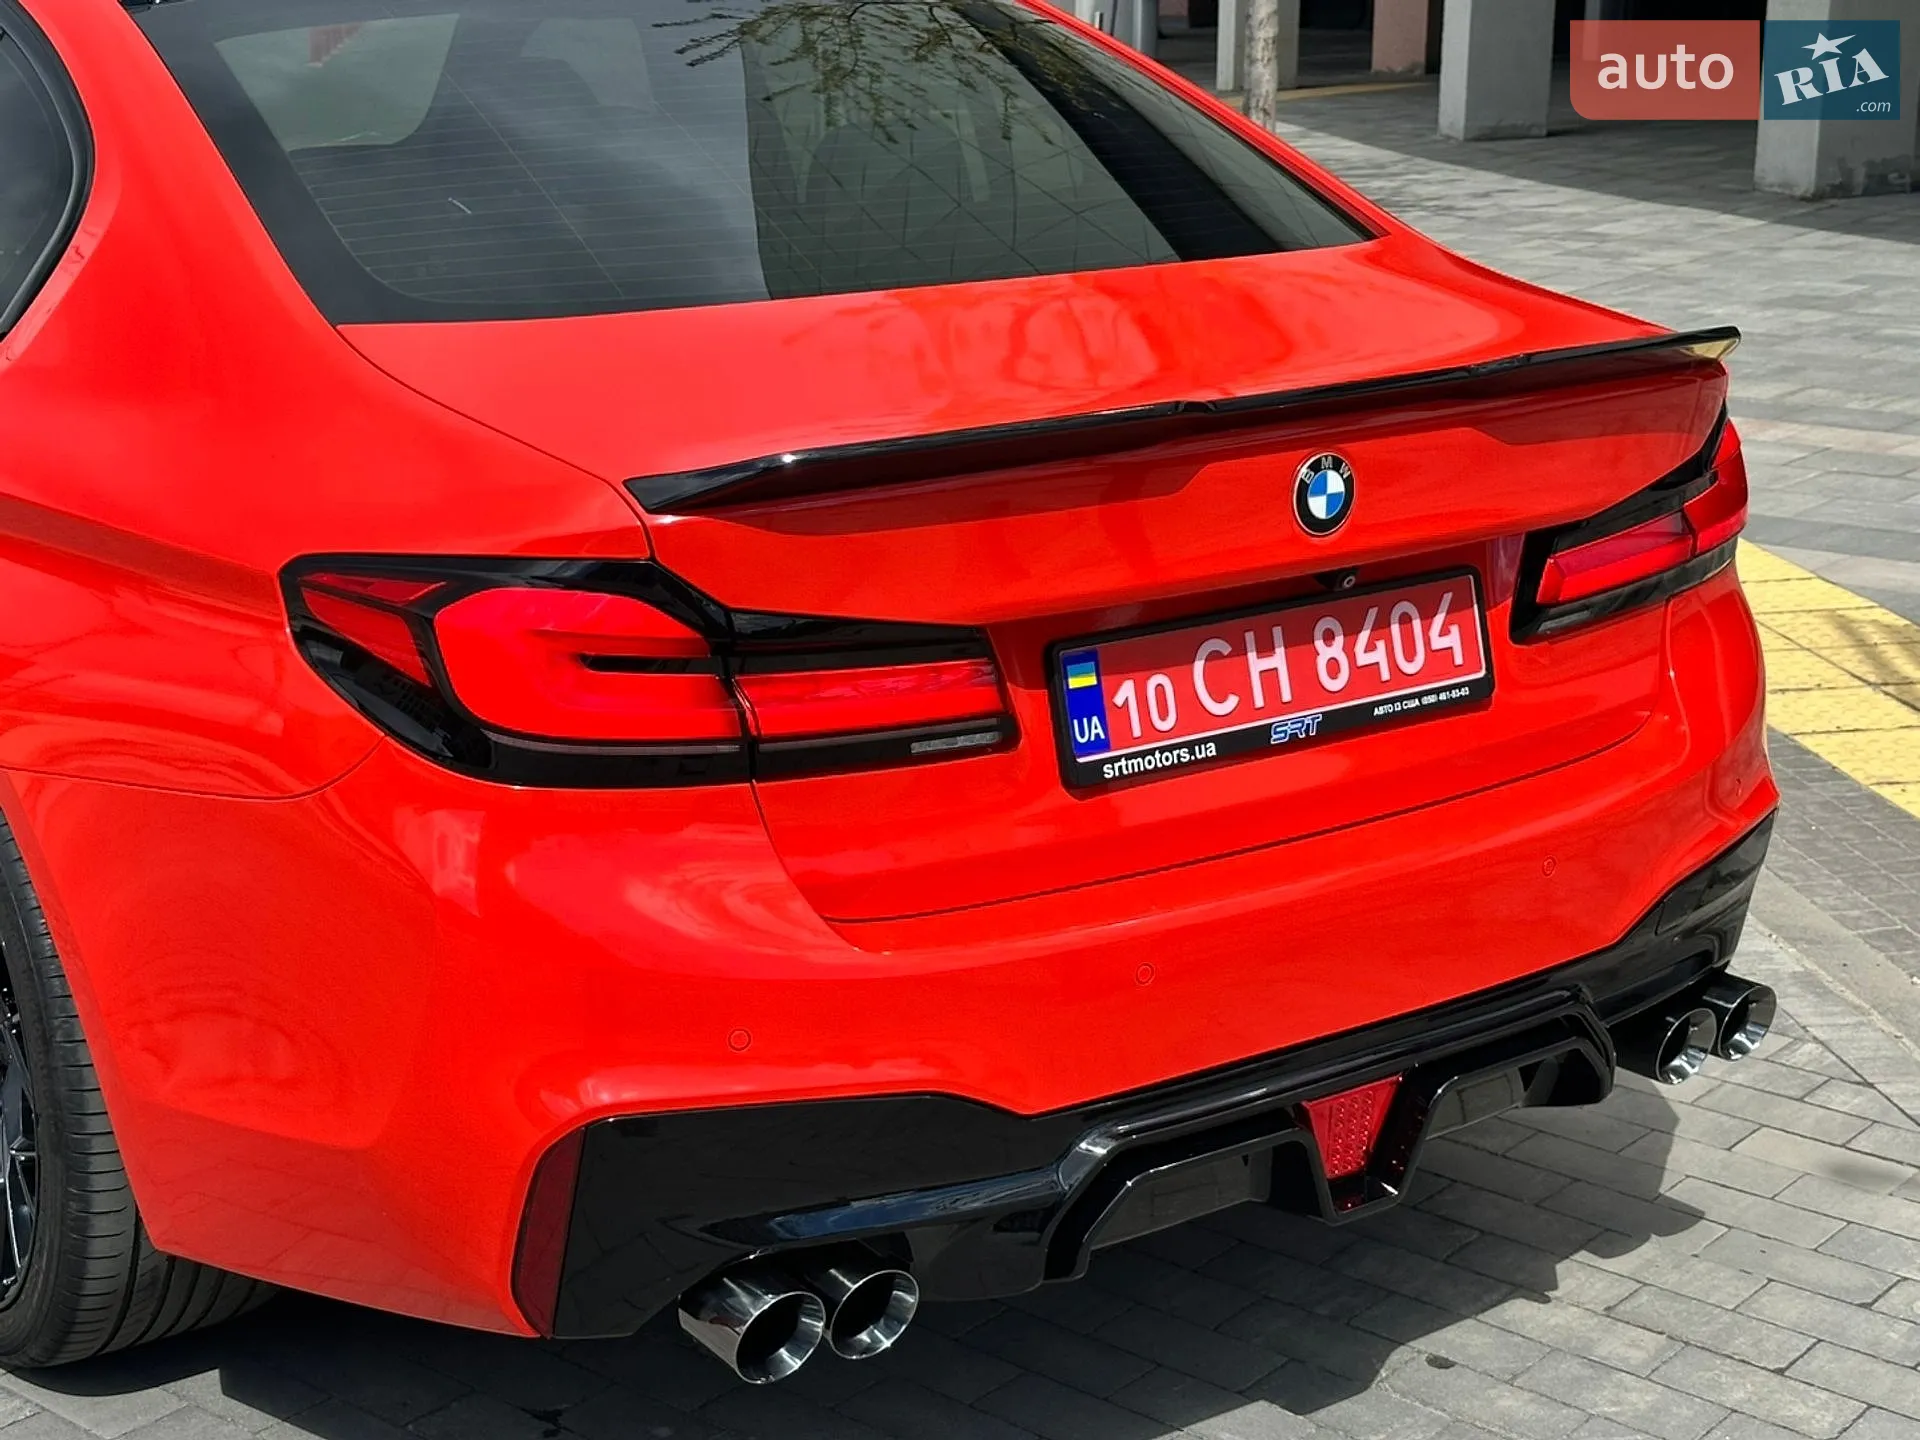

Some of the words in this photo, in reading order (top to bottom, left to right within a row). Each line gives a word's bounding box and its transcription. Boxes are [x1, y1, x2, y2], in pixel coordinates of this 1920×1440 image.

[1301, 455, 1351, 484] BMW
[1112, 673, 1178, 738] 10
[1193, 625, 1292, 717] CH
[1313, 591, 1464, 693] 8404
[1073, 715, 1105, 743] UA
[1270, 714, 1322, 744] SRT
[1103, 742, 1217, 778] srtmotors.ua
